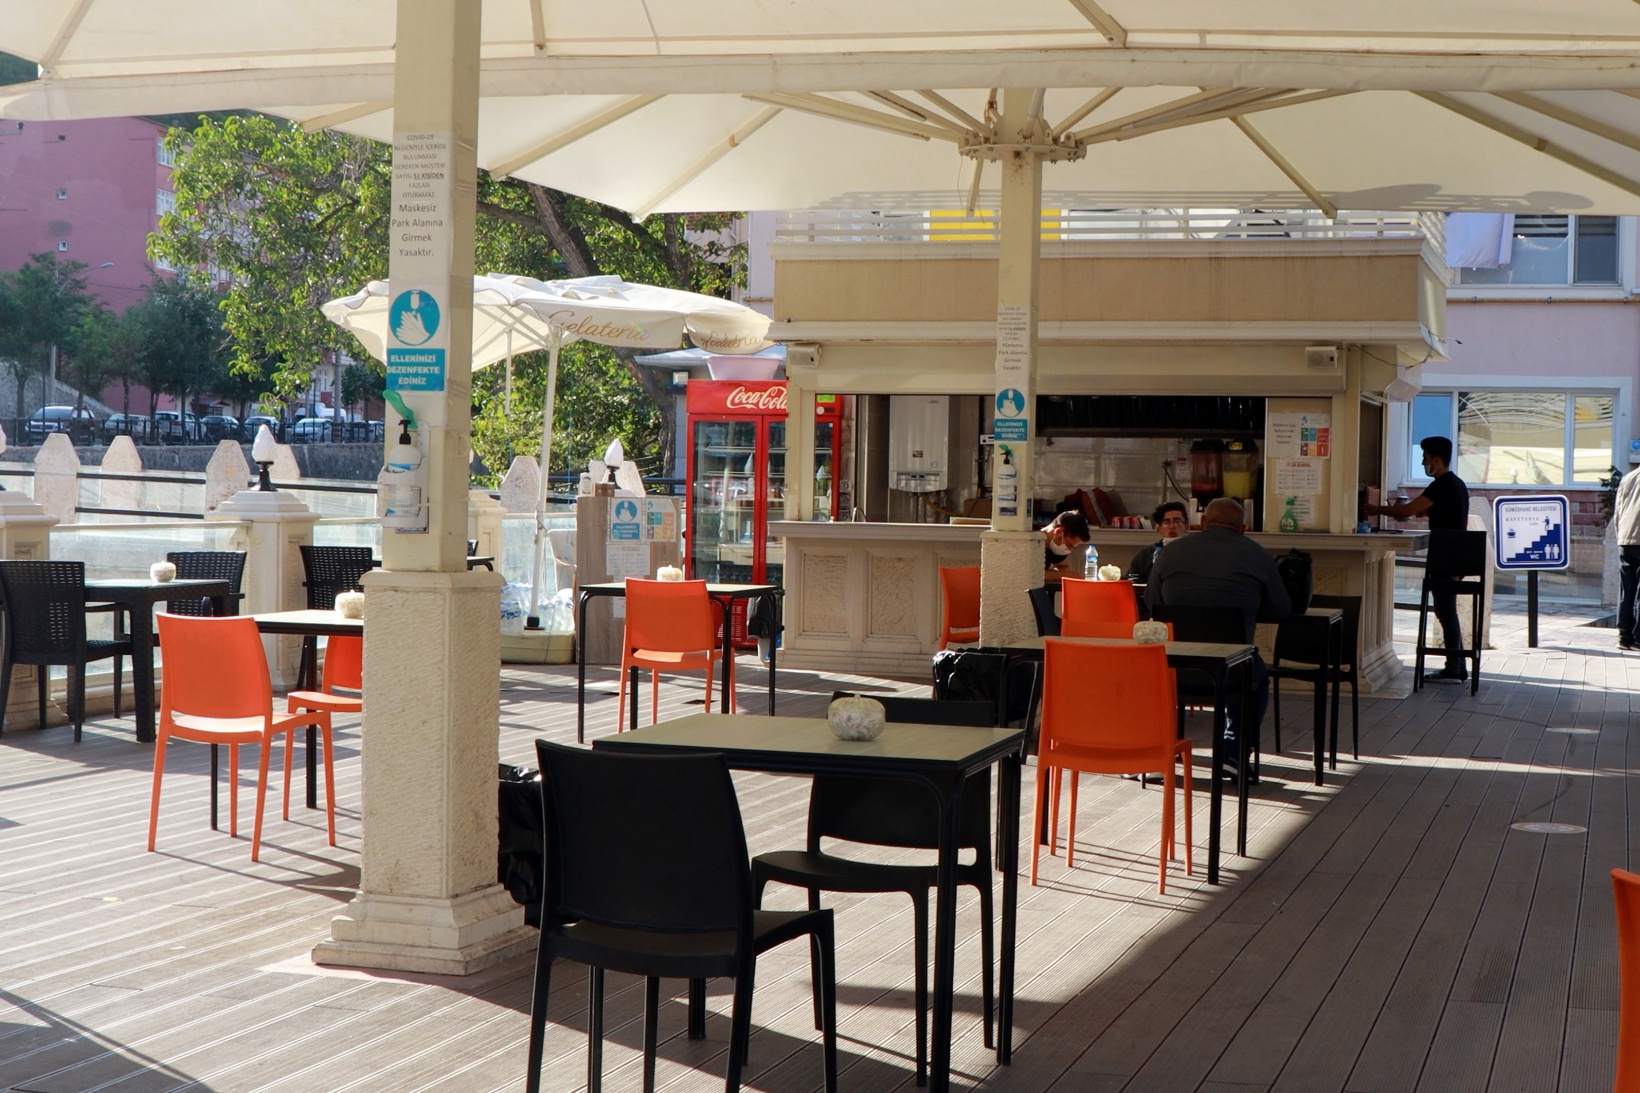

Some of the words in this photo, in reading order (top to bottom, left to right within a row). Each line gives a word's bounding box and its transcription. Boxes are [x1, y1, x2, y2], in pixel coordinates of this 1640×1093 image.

[399, 204, 437, 212] Maskesiz
[392, 219, 410, 227] Park
[412, 218, 443, 227] Alanına
[402, 233, 432, 242] Girmek
[399, 248, 434, 257] Yasaktır.
[390, 353, 436, 363] ELLERİNİZİ
[386, 366, 440, 374] DEZENFEKTE
[398, 376, 427, 386] EDİNİZ
